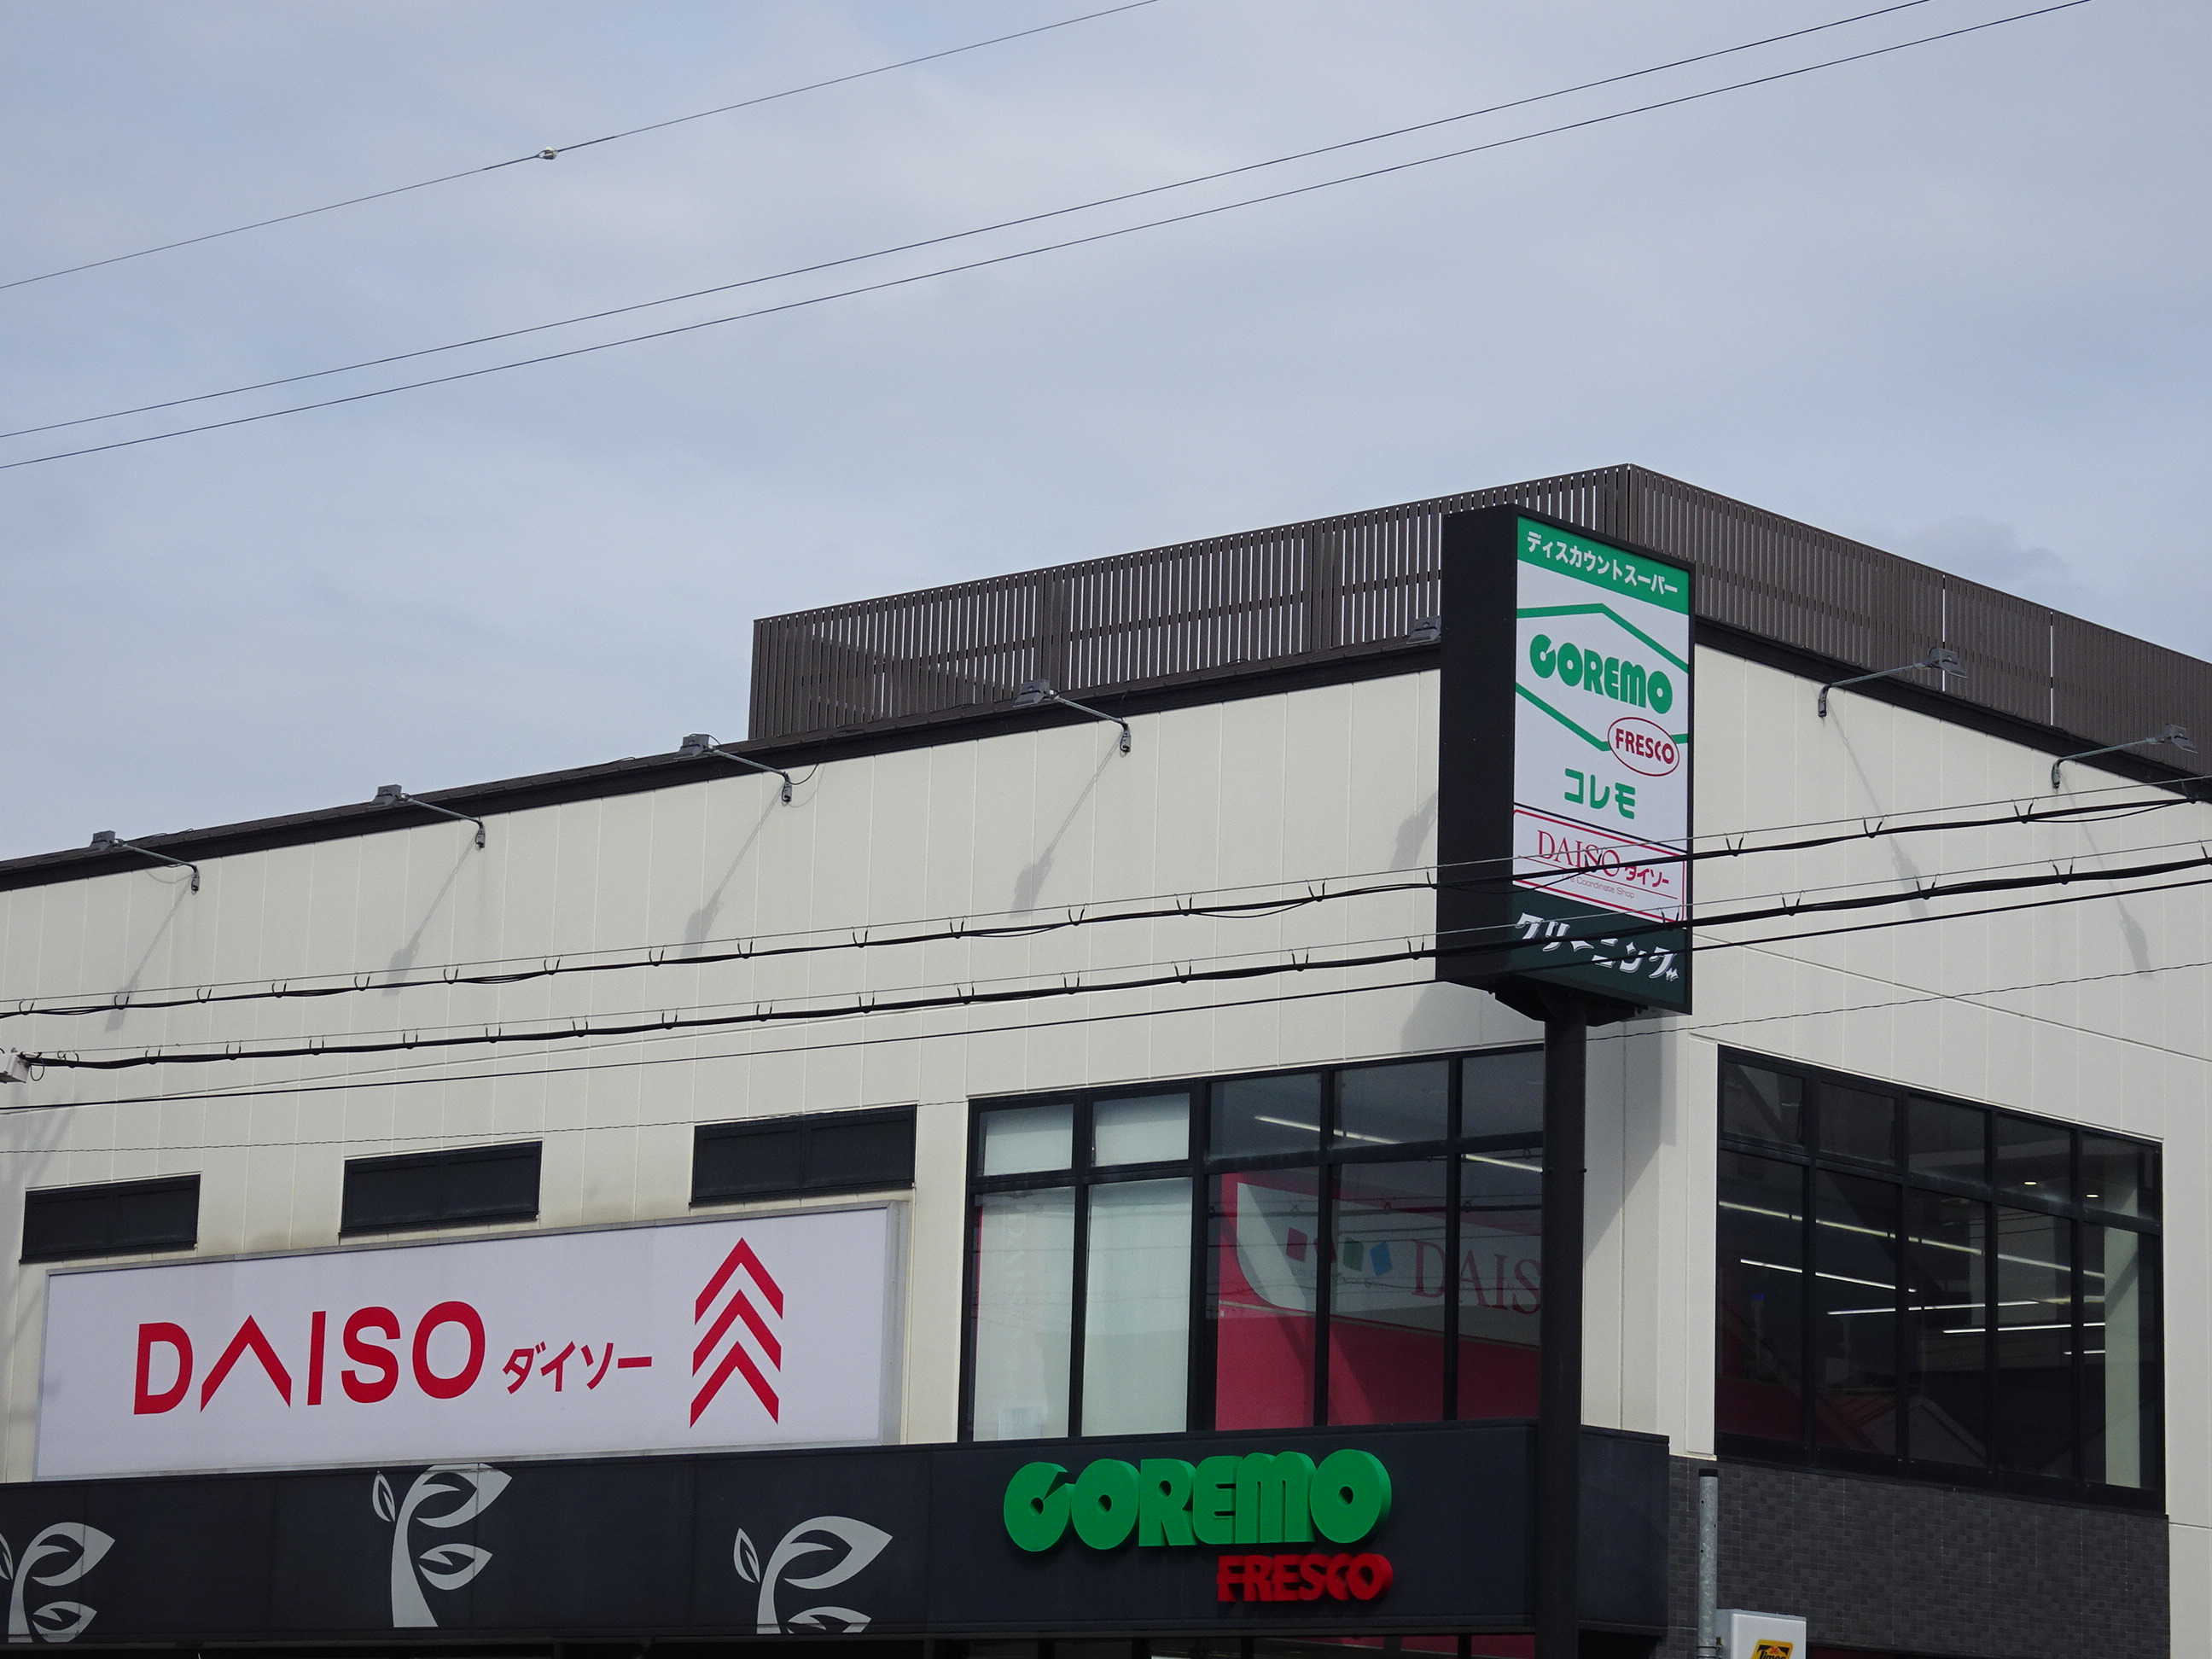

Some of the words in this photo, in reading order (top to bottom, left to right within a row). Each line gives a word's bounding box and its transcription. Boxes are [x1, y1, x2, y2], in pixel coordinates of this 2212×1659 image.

[1527, 531, 1679, 595] ディスカウントスーパー
[1615, 728, 1675, 765] FRESCO
[1564, 767, 1636, 820] コレモ
[1537, 830, 1621, 877] DAISO
[1576, 876, 1615, 894] Coordinate
[1616, 887, 1635, 899] Shop
[1410, 1238, 1542, 1315] DAIS
[133, 1300, 486, 1416] DAISO
[502, 1340, 653, 1395] ダイソー
[1216, 1552, 1394, 1603] FRESCO
